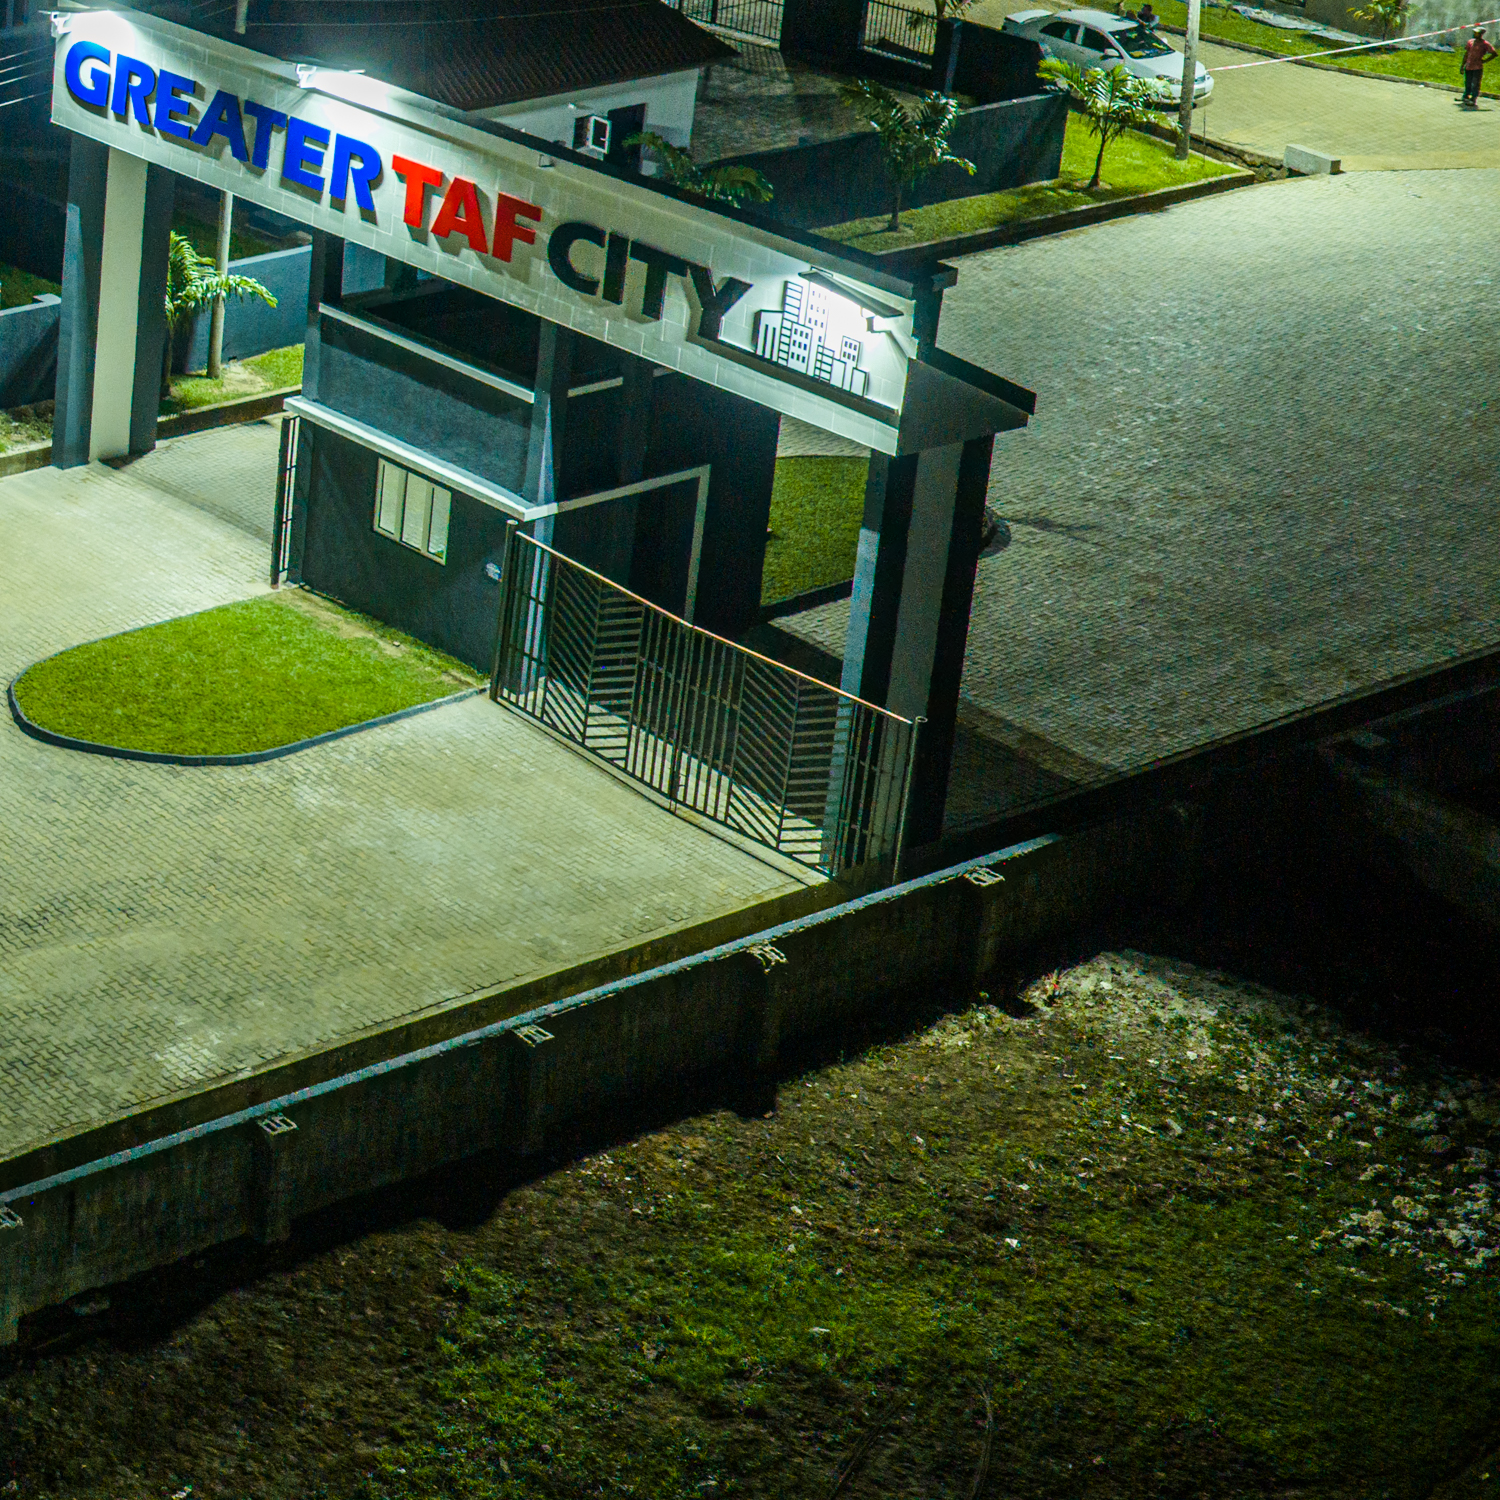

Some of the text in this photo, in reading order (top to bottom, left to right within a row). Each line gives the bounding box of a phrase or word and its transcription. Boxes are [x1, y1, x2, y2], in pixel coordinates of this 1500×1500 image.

[64, 40, 753, 340] GREATER TAF CITY
